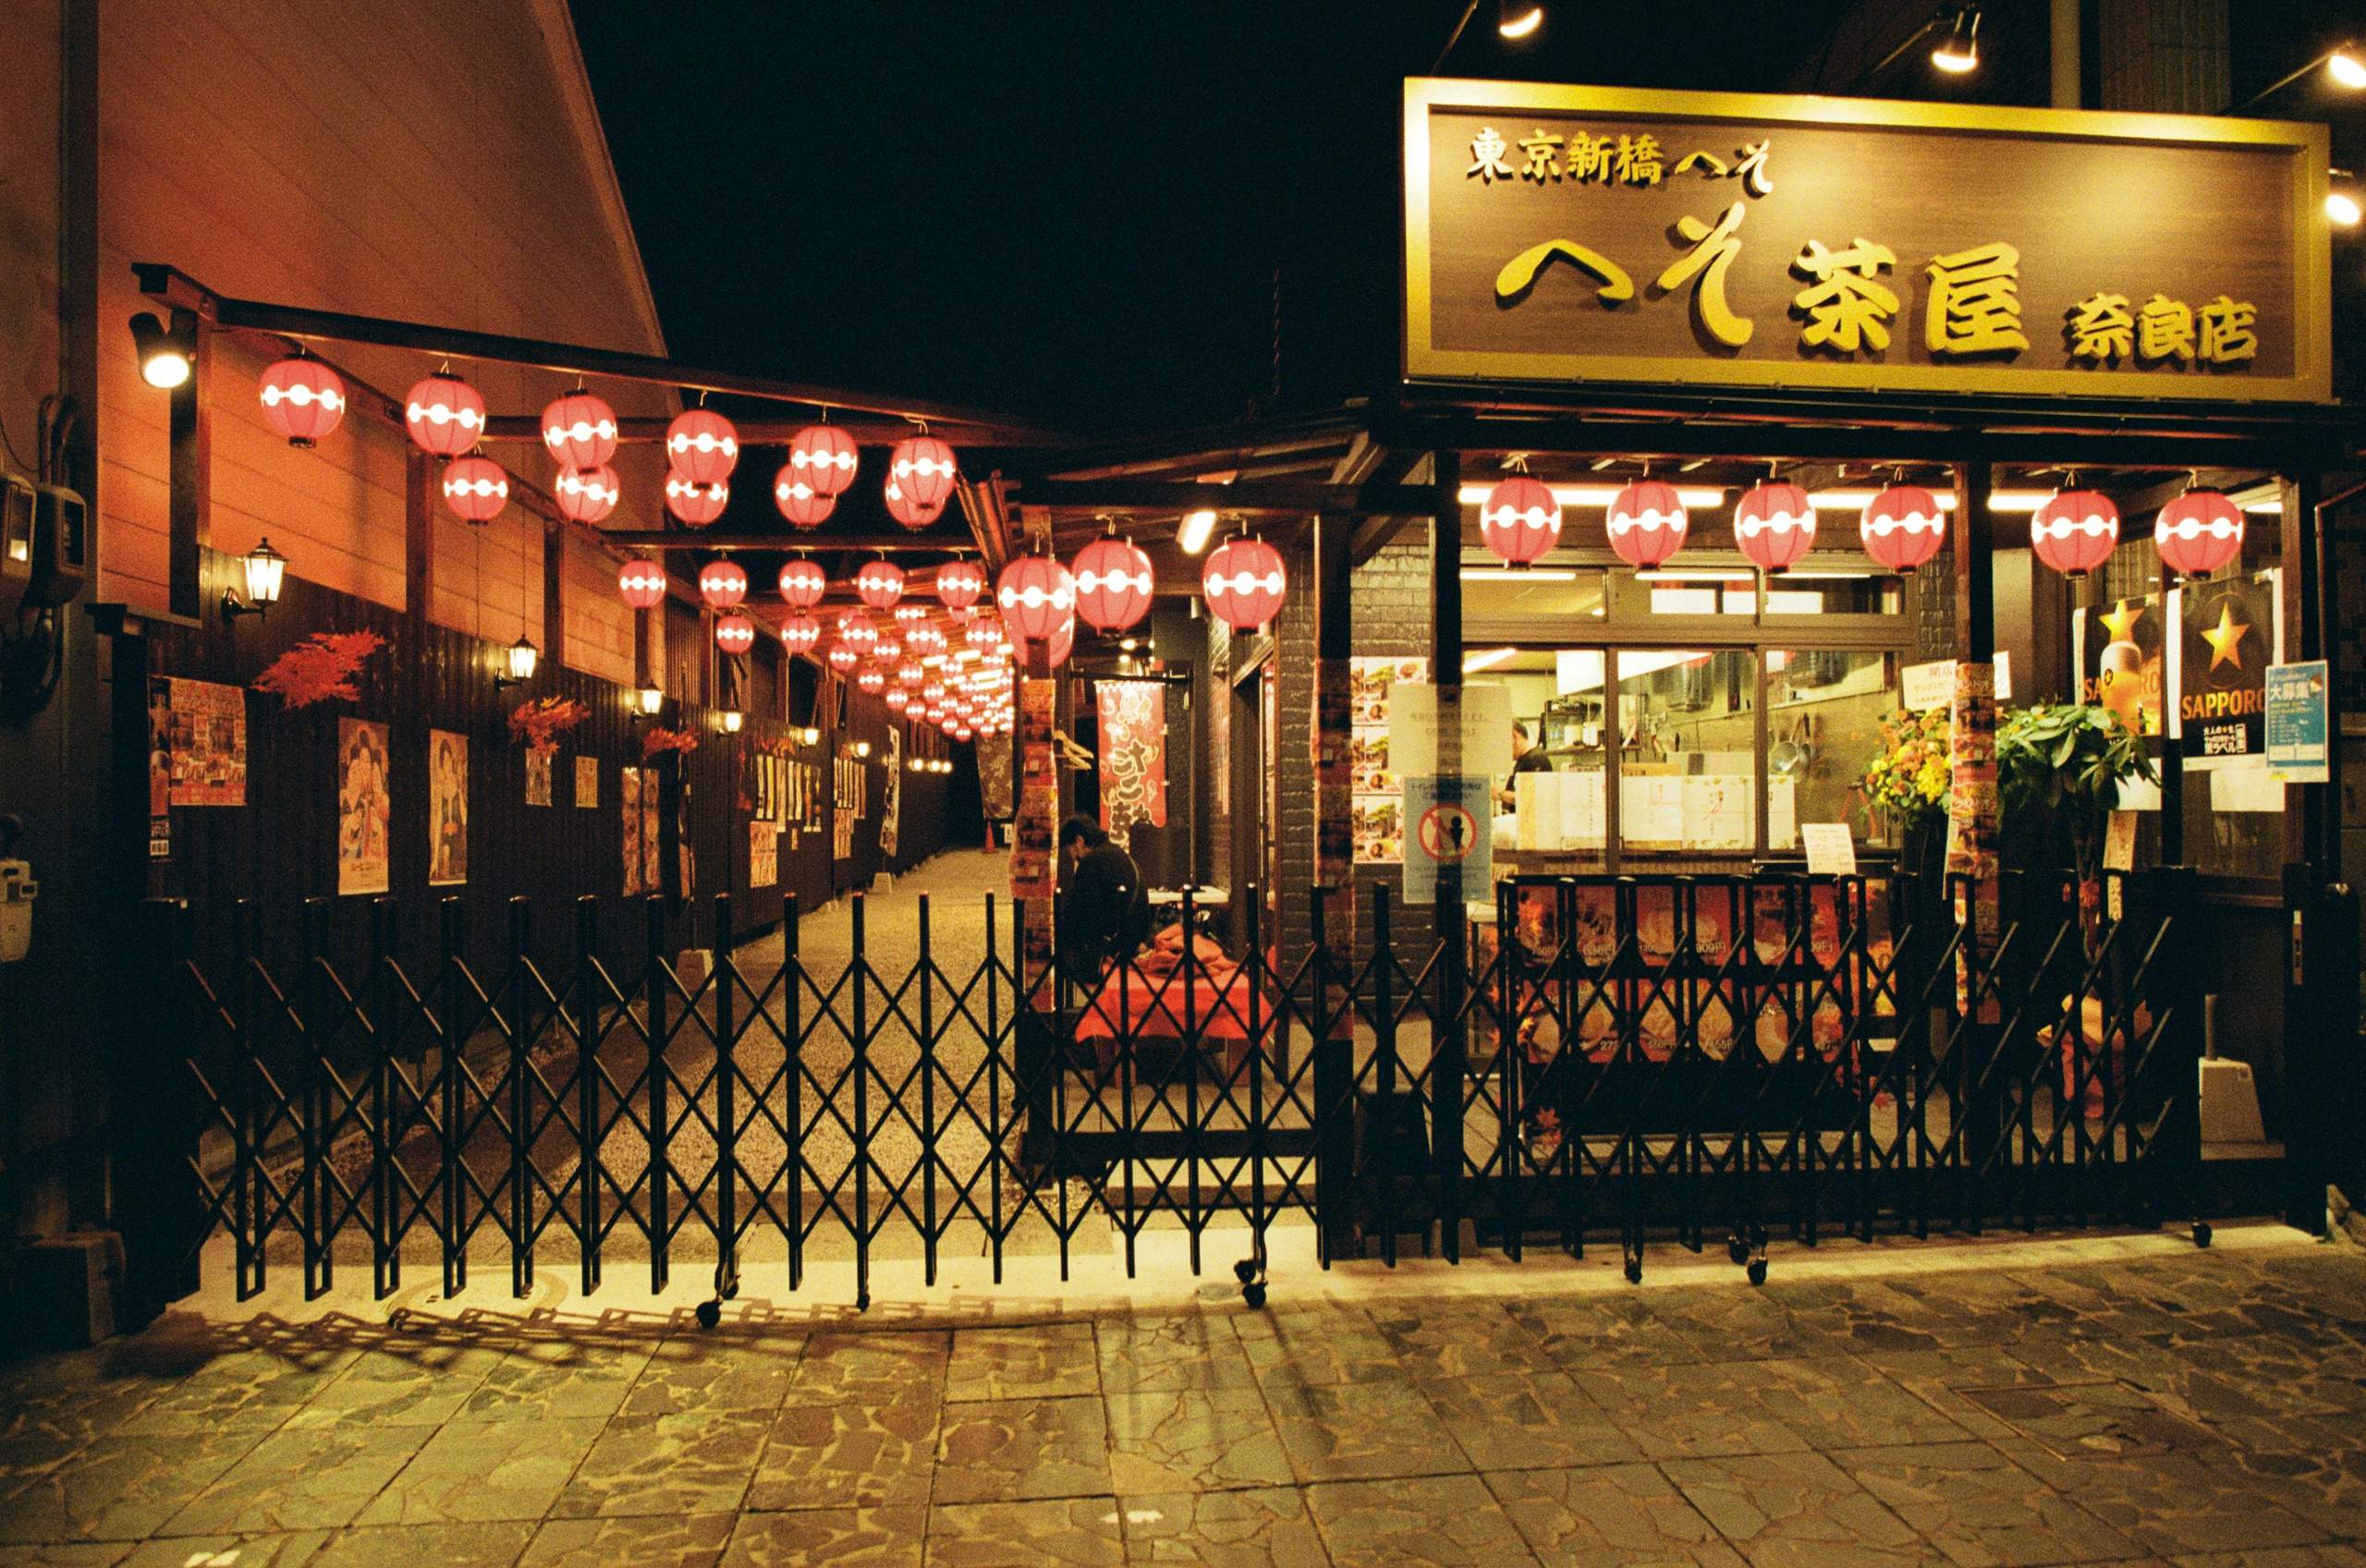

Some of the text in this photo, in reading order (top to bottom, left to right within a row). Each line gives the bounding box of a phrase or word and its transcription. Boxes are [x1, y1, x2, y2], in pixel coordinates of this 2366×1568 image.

[1467, 126, 1774, 195] 東京新橋へそ
[2069, 290, 2258, 364] 奈良店
